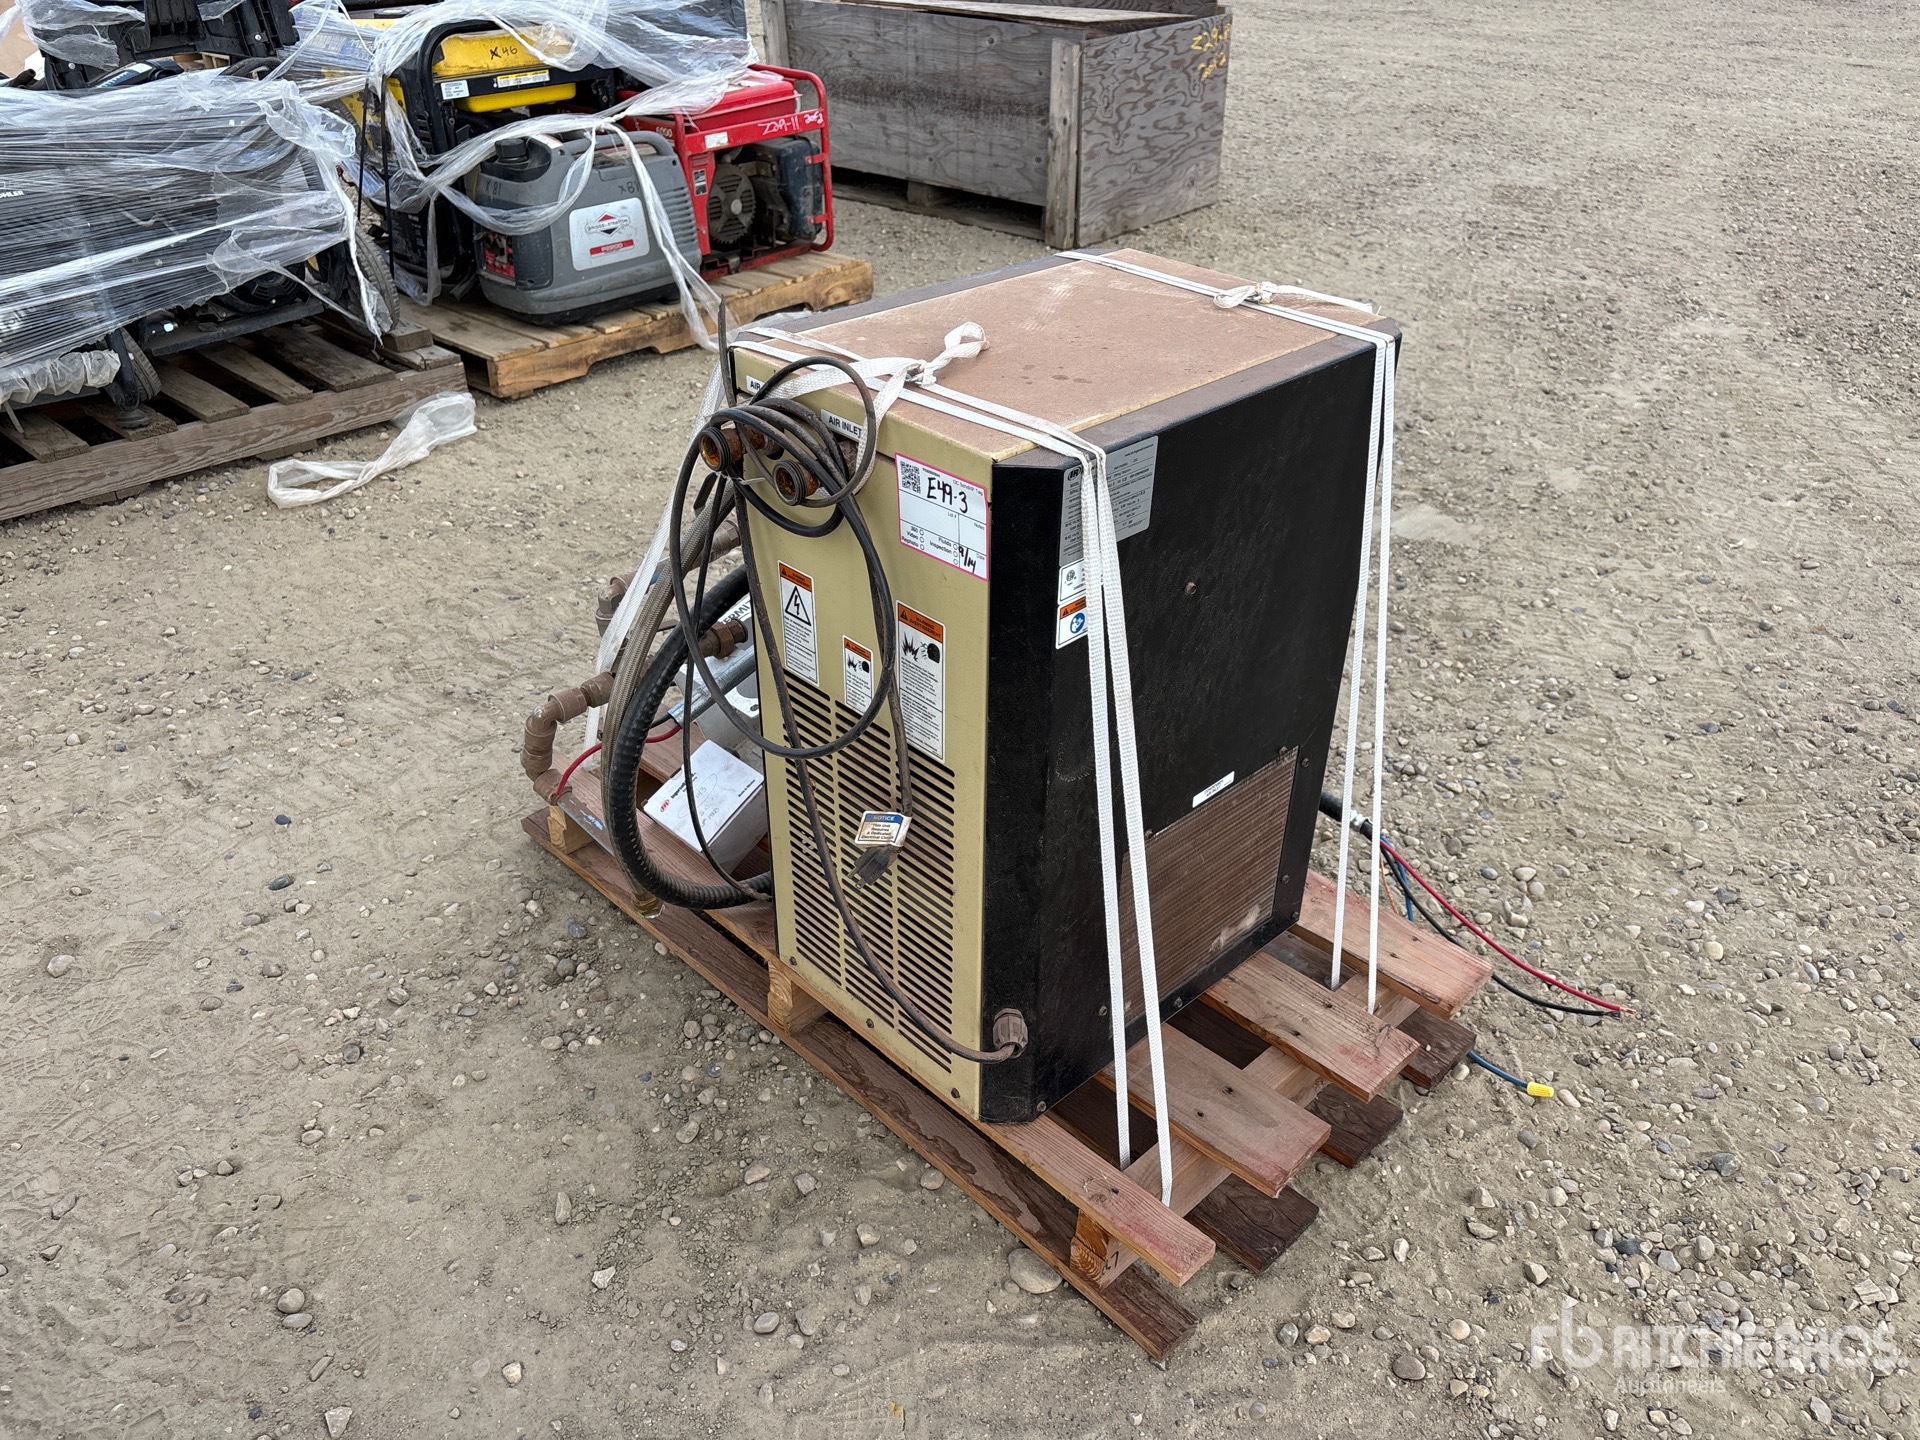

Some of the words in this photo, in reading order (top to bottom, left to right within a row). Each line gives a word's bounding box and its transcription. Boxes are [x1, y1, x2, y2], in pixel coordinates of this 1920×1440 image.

[829, 415, 841, 430] AIR
[842, 421, 862, 439] INLET
[927, 476, 968, 514] E49-3
[906, 531, 919, 541] Video
[929, 540, 952, 555] Inspection
